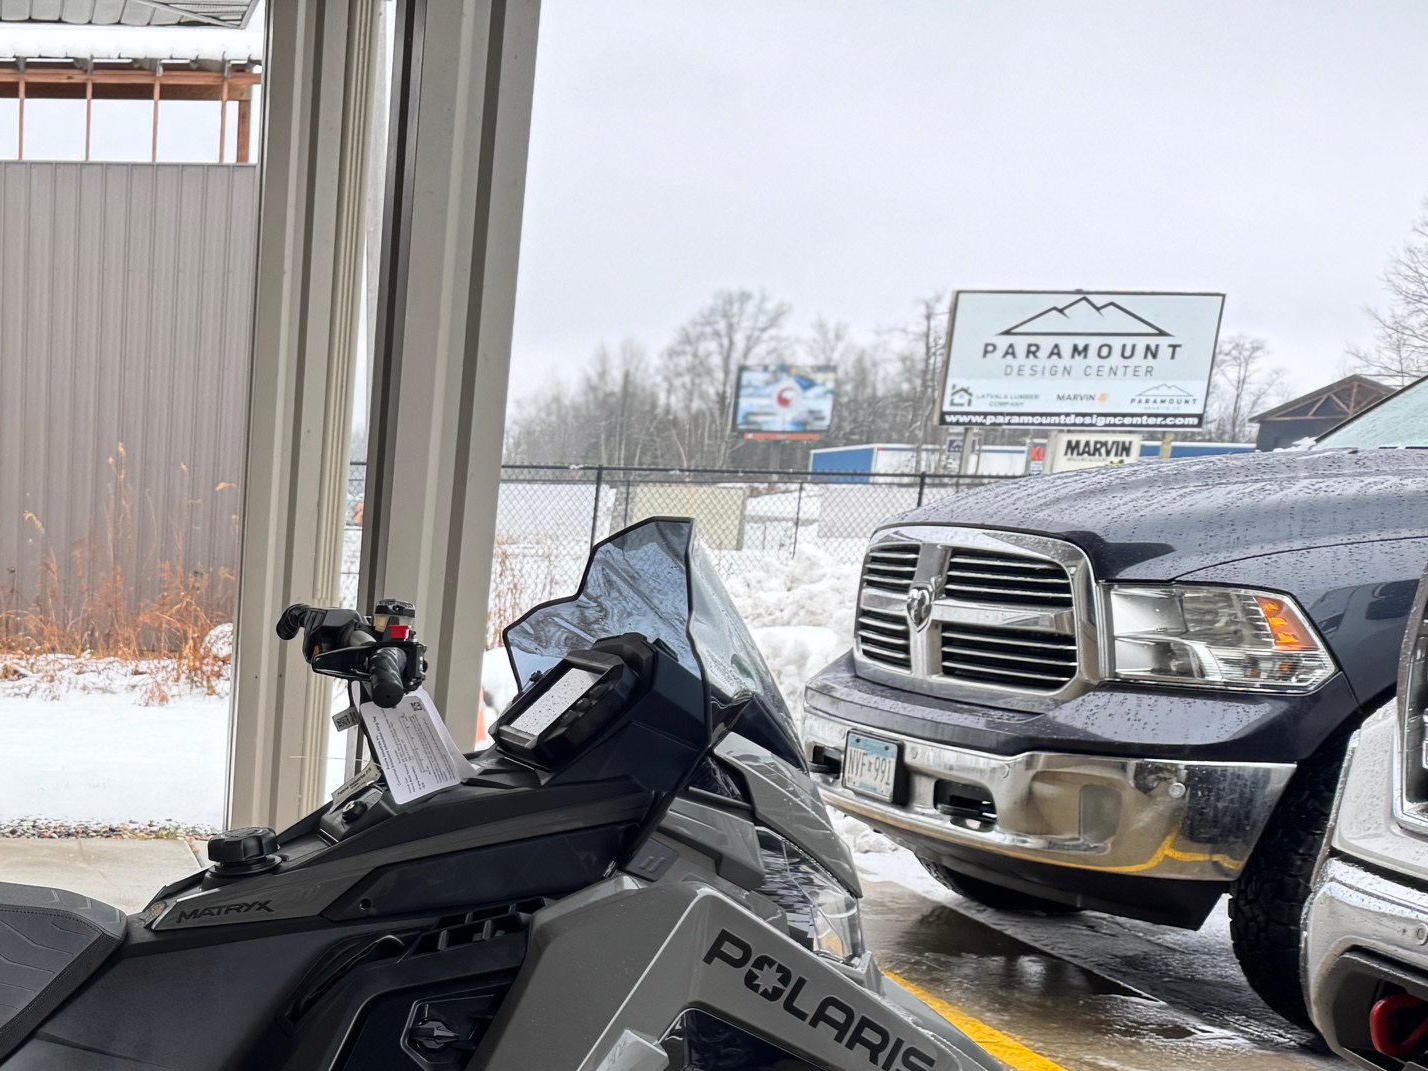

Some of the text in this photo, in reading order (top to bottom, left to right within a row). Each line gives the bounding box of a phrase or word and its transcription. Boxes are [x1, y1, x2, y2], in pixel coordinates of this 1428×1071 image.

[982, 342, 1182, 361] PARAMOUNT
[1003, 364, 1155, 378] DESIGN CENTER
[1056, 392, 1096, 402] MARVIN
[944, 412, 1199, 427] www.paramountdesigncenter.com
[1063, 439, 1134, 458] MARVIN
[176, 900, 275, 924] MATRYX
